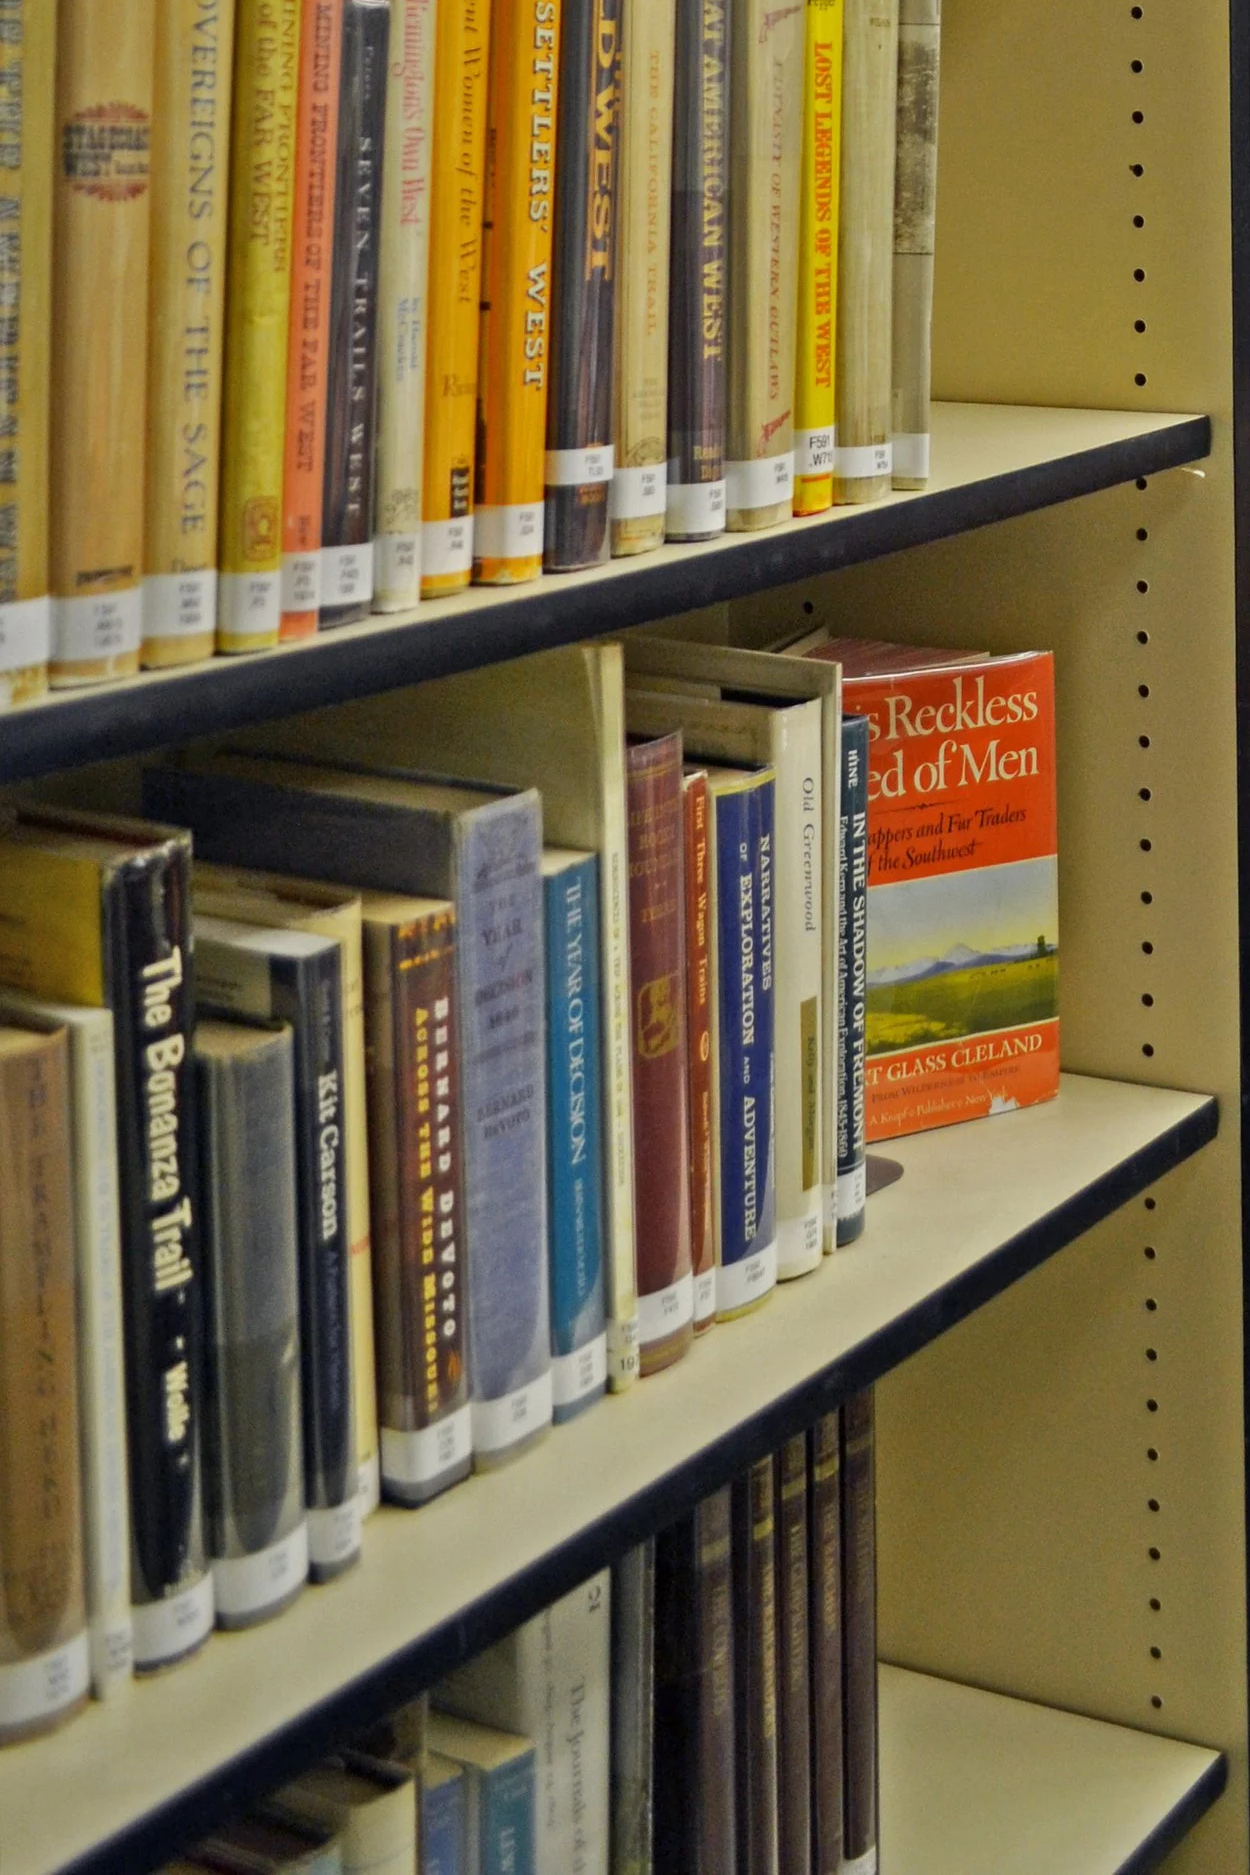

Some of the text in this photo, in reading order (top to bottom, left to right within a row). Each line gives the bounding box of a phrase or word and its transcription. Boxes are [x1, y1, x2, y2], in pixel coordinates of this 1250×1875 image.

[312, 3, 333, 93] MINING
[251, 3, 278, 247] of the FAR WEST
[460, 47, 481, 144] Women
[530, 0, 555, 233] SETTLERS'
[273, 101, 296, 274] FRONTIERS
[306, 102, 331, 239] FRONTIERS
[401, 127, 426, 172] Own
[456, 153, 477, 180] of
[590, 84, 617, 281] WEST
[702, 53, 724, 247] AMERICAN
[770, 172, 782, 198] OF
[400, 176, 425, 228] West
[460, 187, 476, 227] the
[646, 51, 660, 336] THE CALIFORNIA TRAIL
[814, 42, 834, 389] LOST LEGENDS OF THE WEST
[186, 241, 214, 295] OF
[306, 243, 324, 271] OF
[457, 238, 475, 305] West
[769, 203, 782, 299] WESTERN
[302, 278, 322, 330] THE
[523, 262, 548, 392] WEST
[702, 259, 722, 362] WEST
[185, 325, 211, 404] THE
[299, 339, 320, 392] FAR
[768, 305, 782, 401] OUTLAWS
[180, 423, 207, 536] SAGE
[296, 400, 317, 473] WEST
[809, 436, 830, 448] F591
[884, 675, 1039, 741] Reckless
[848, 749, 859, 790] HINE
[868, 740, 1040, 801] ed of Men
[739, 843, 748, 862] OF
[802, 777, 816, 933] Old Greenwood
[868, 803, 1027, 849] appers and Fur Traders
[878, 838, 979, 872] the Southwest
[566, 876, 587, 926] THE
[695, 796, 709, 1005] First Three Wagon Trains
[760, 835, 772, 991] NARRATIVES
[566, 927, 586, 997] YEAR
[740, 874, 754, 1046] EXPLORATION
[851, 812, 866, 1151] IN THE SHADOW OF FREMONT
[567, 999, 587, 1034] OF
[887, 1054, 946, 1083] GLASS
[950, 1033, 1043, 1067] CLELAND
[317, 1070, 339, 1123] Kit
[414, 1007, 430, 1114] ACROSS
[432, 996, 452, 1174] BERNARD
[568, 1038, 588, 1165] DECISION
[142, 946, 195, 1292] The Bonanza Trail
[418, 1123, 432, 1179] THE
[318, 1124, 342, 1240] Carson
[742, 1095, 757, 1242] ADVENTURE
[163, 1361, 189, 1443] Wolle
